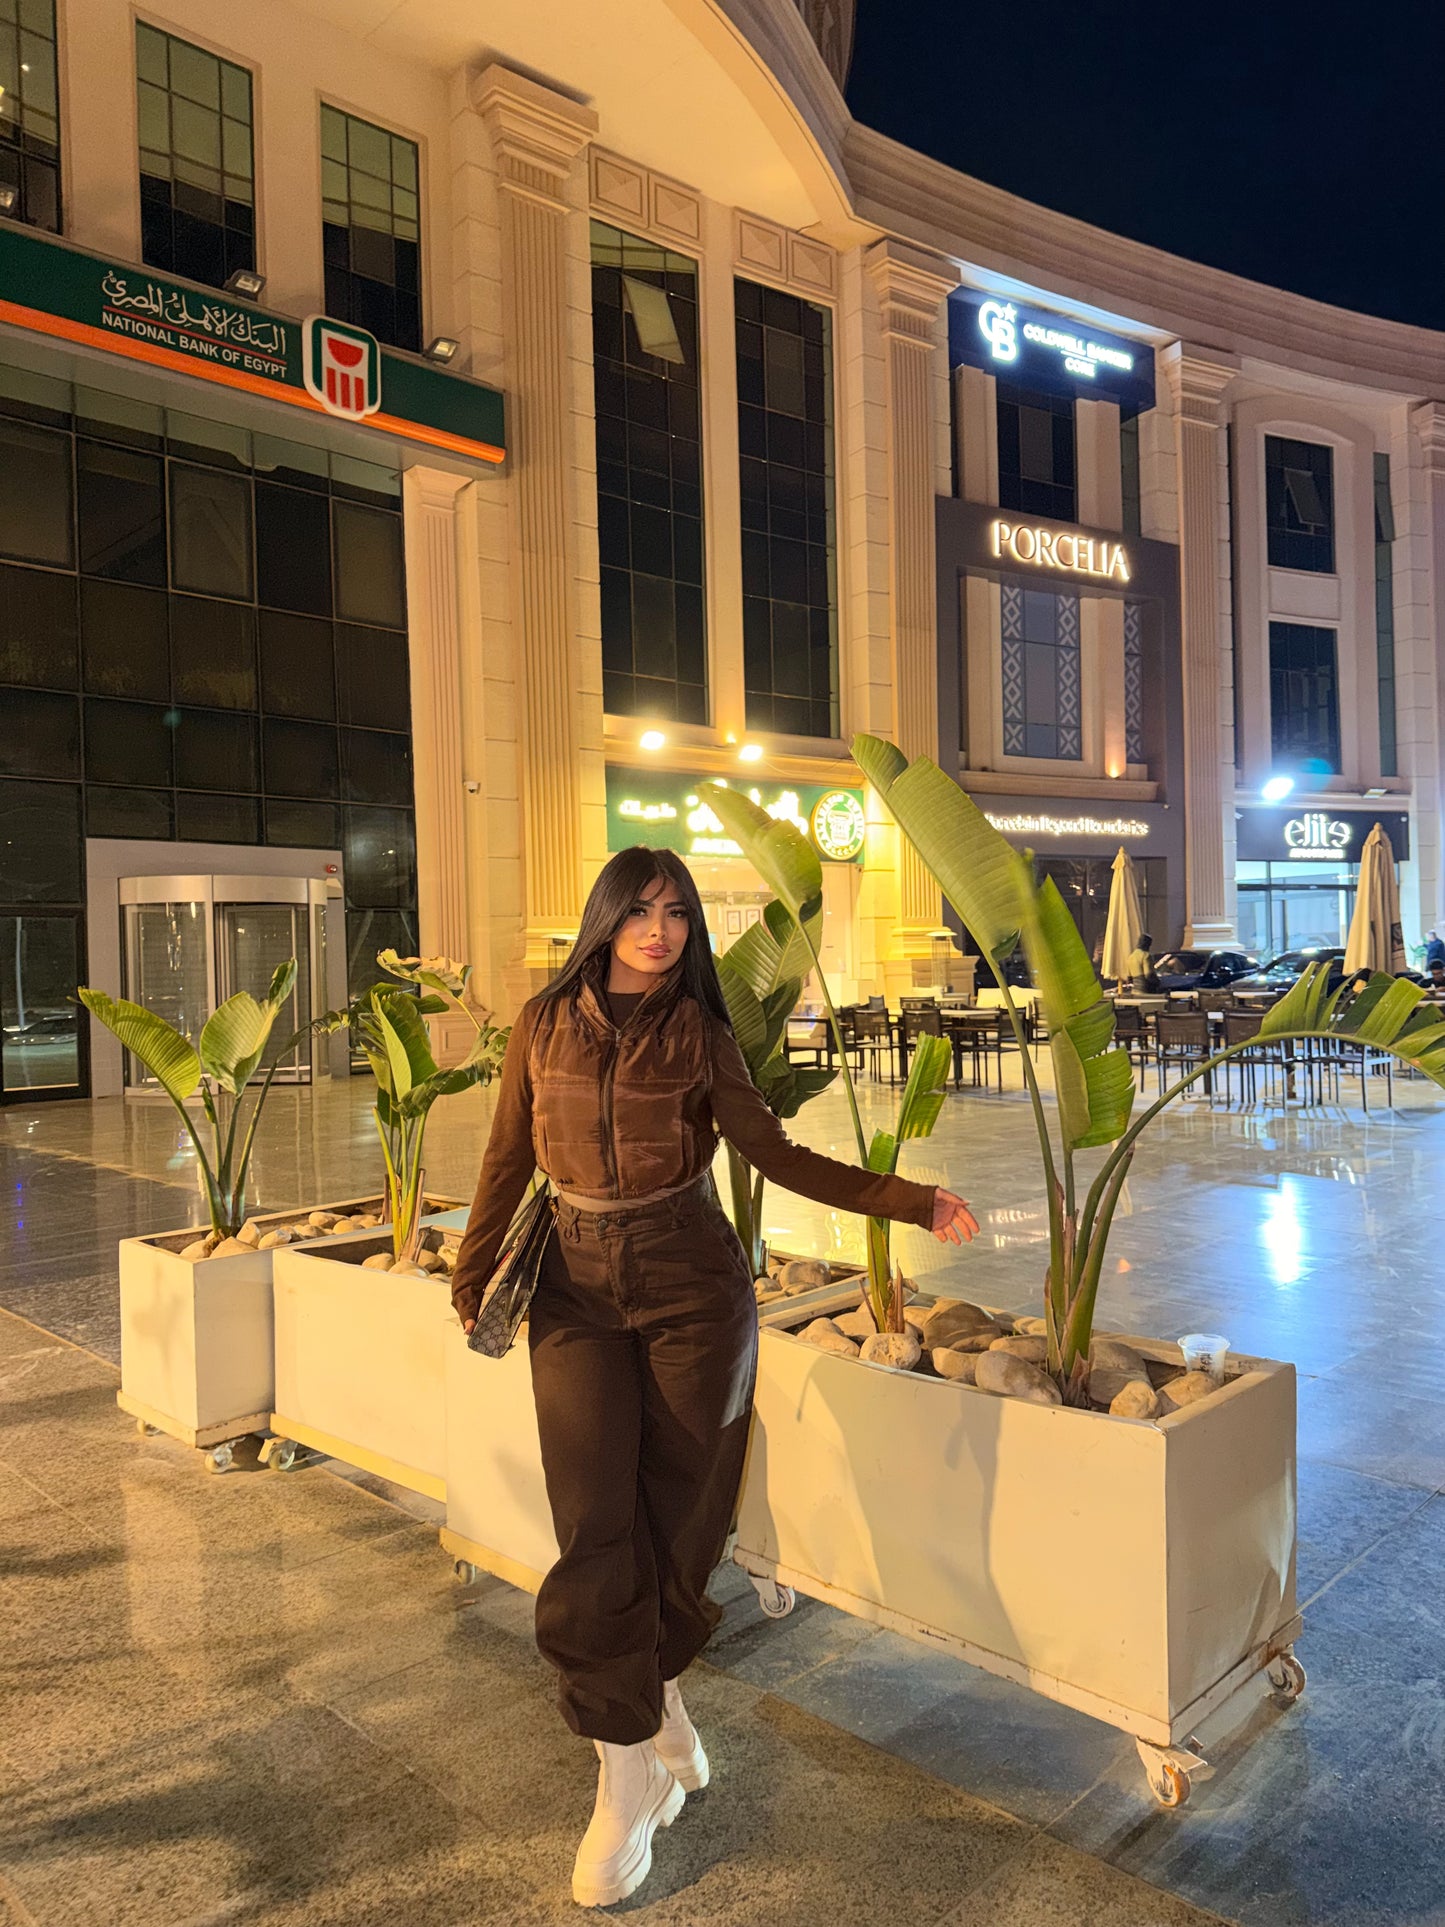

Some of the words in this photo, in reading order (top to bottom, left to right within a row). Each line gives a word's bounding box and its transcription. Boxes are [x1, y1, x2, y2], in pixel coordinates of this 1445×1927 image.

[102, 312, 176, 346] NATIONAL
[179, 335, 219, 359] BANK
[222, 349, 241, 364] OF
[244, 355, 287, 379] EGYPT
[1022, 323, 1087, 356] COLDWELL
[992, 519, 1131, 581] PORCELIA
[1284, 813, 1352, 848] elite
